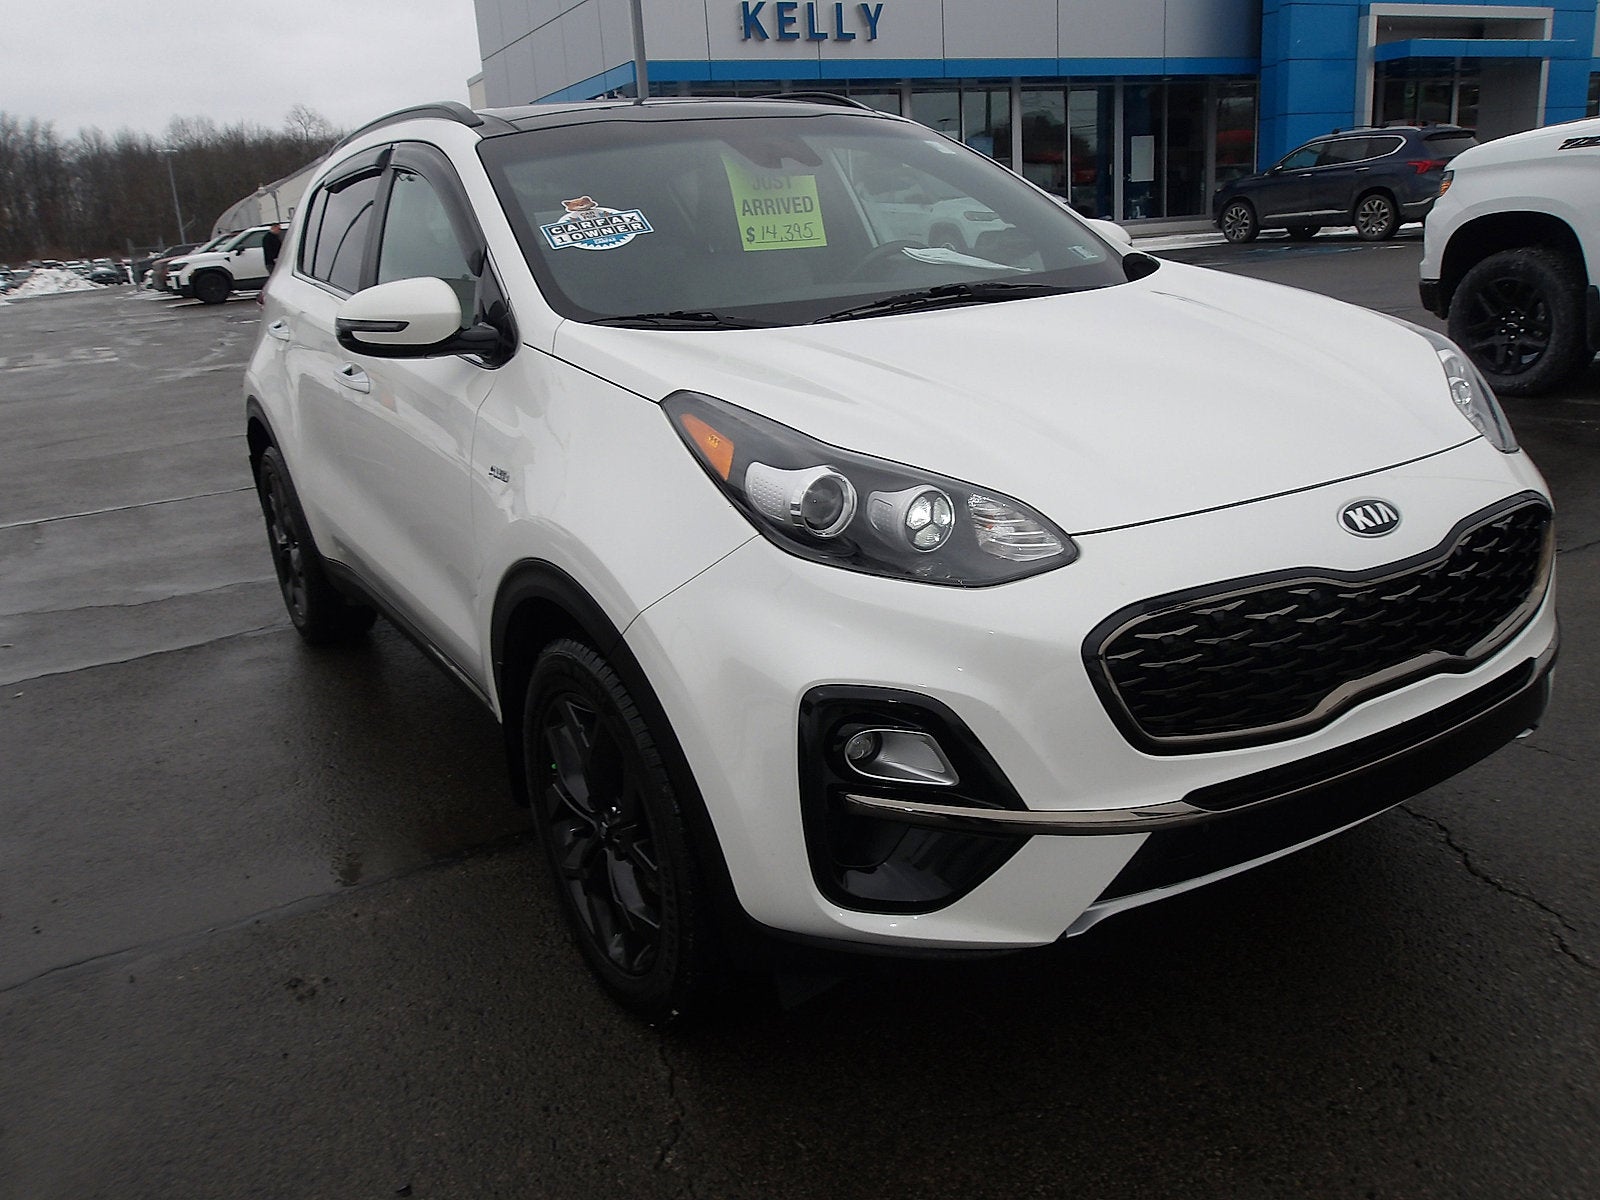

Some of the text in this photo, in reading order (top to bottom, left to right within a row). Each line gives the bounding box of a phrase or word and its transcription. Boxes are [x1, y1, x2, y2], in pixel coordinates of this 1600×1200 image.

[741, 1, 884, 41] KELLY
[751, 175, 793, 191] JUST
[742, 196, 814, 217] ARRIVED
[549, 215, 637, 235] CARFAX
[1345, 502, 1398, 531] KIA
